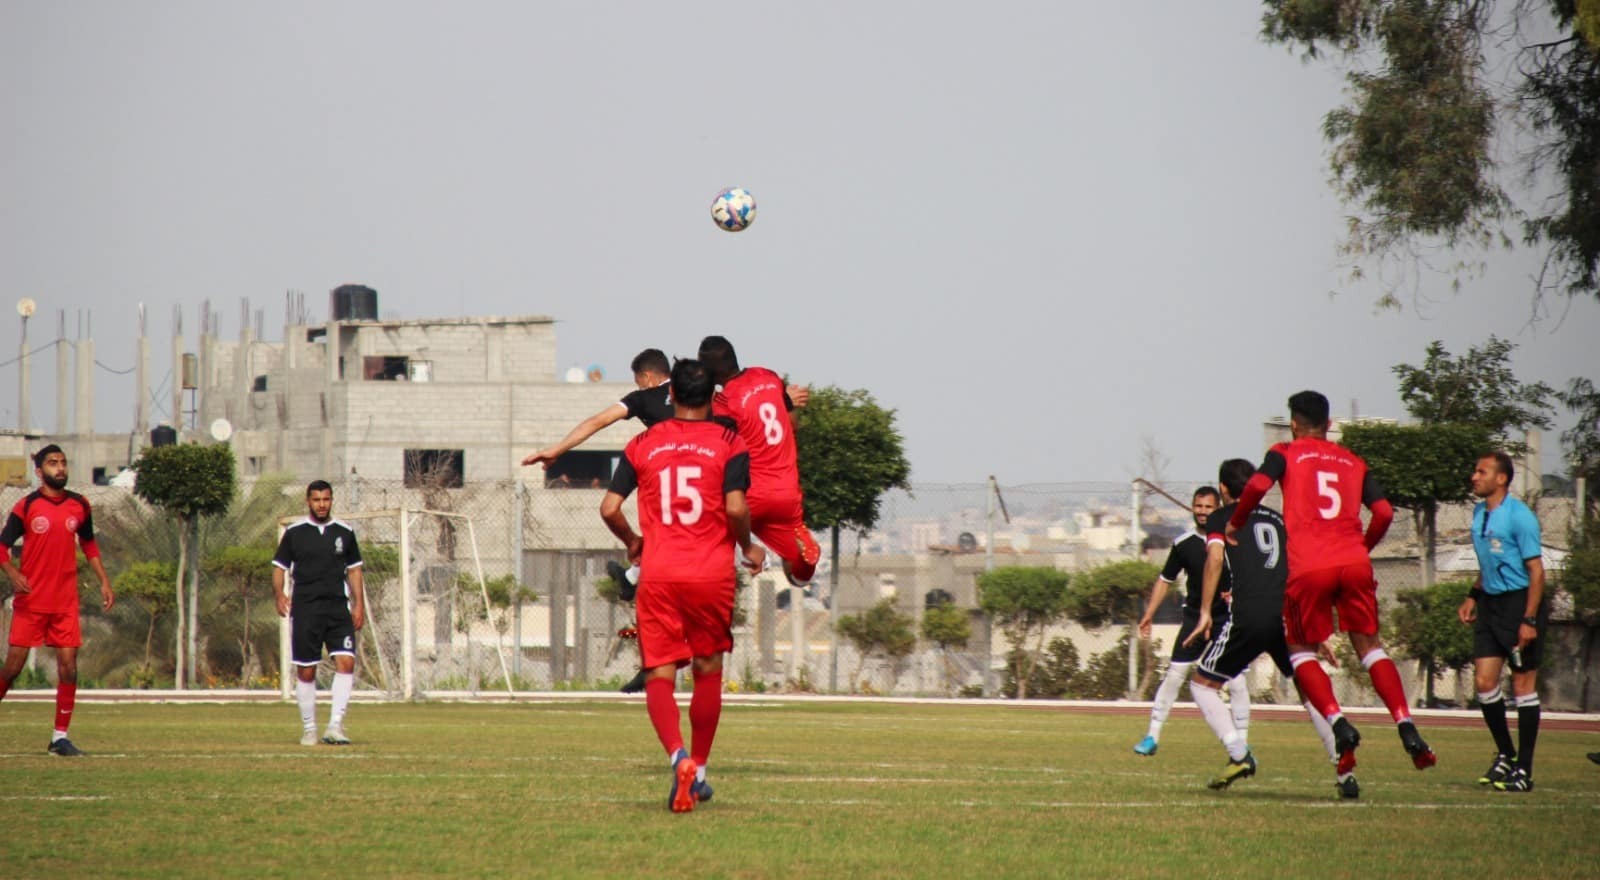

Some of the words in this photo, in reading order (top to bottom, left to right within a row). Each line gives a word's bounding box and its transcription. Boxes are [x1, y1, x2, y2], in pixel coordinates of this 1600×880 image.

[759, 402, 783, 445] 8
[658, 466, 703, 525] 15
[1316, 470, 1342, 520] 5
[1253, 521, 1280, 569] 9
[343, 635, 353, 649] 6
